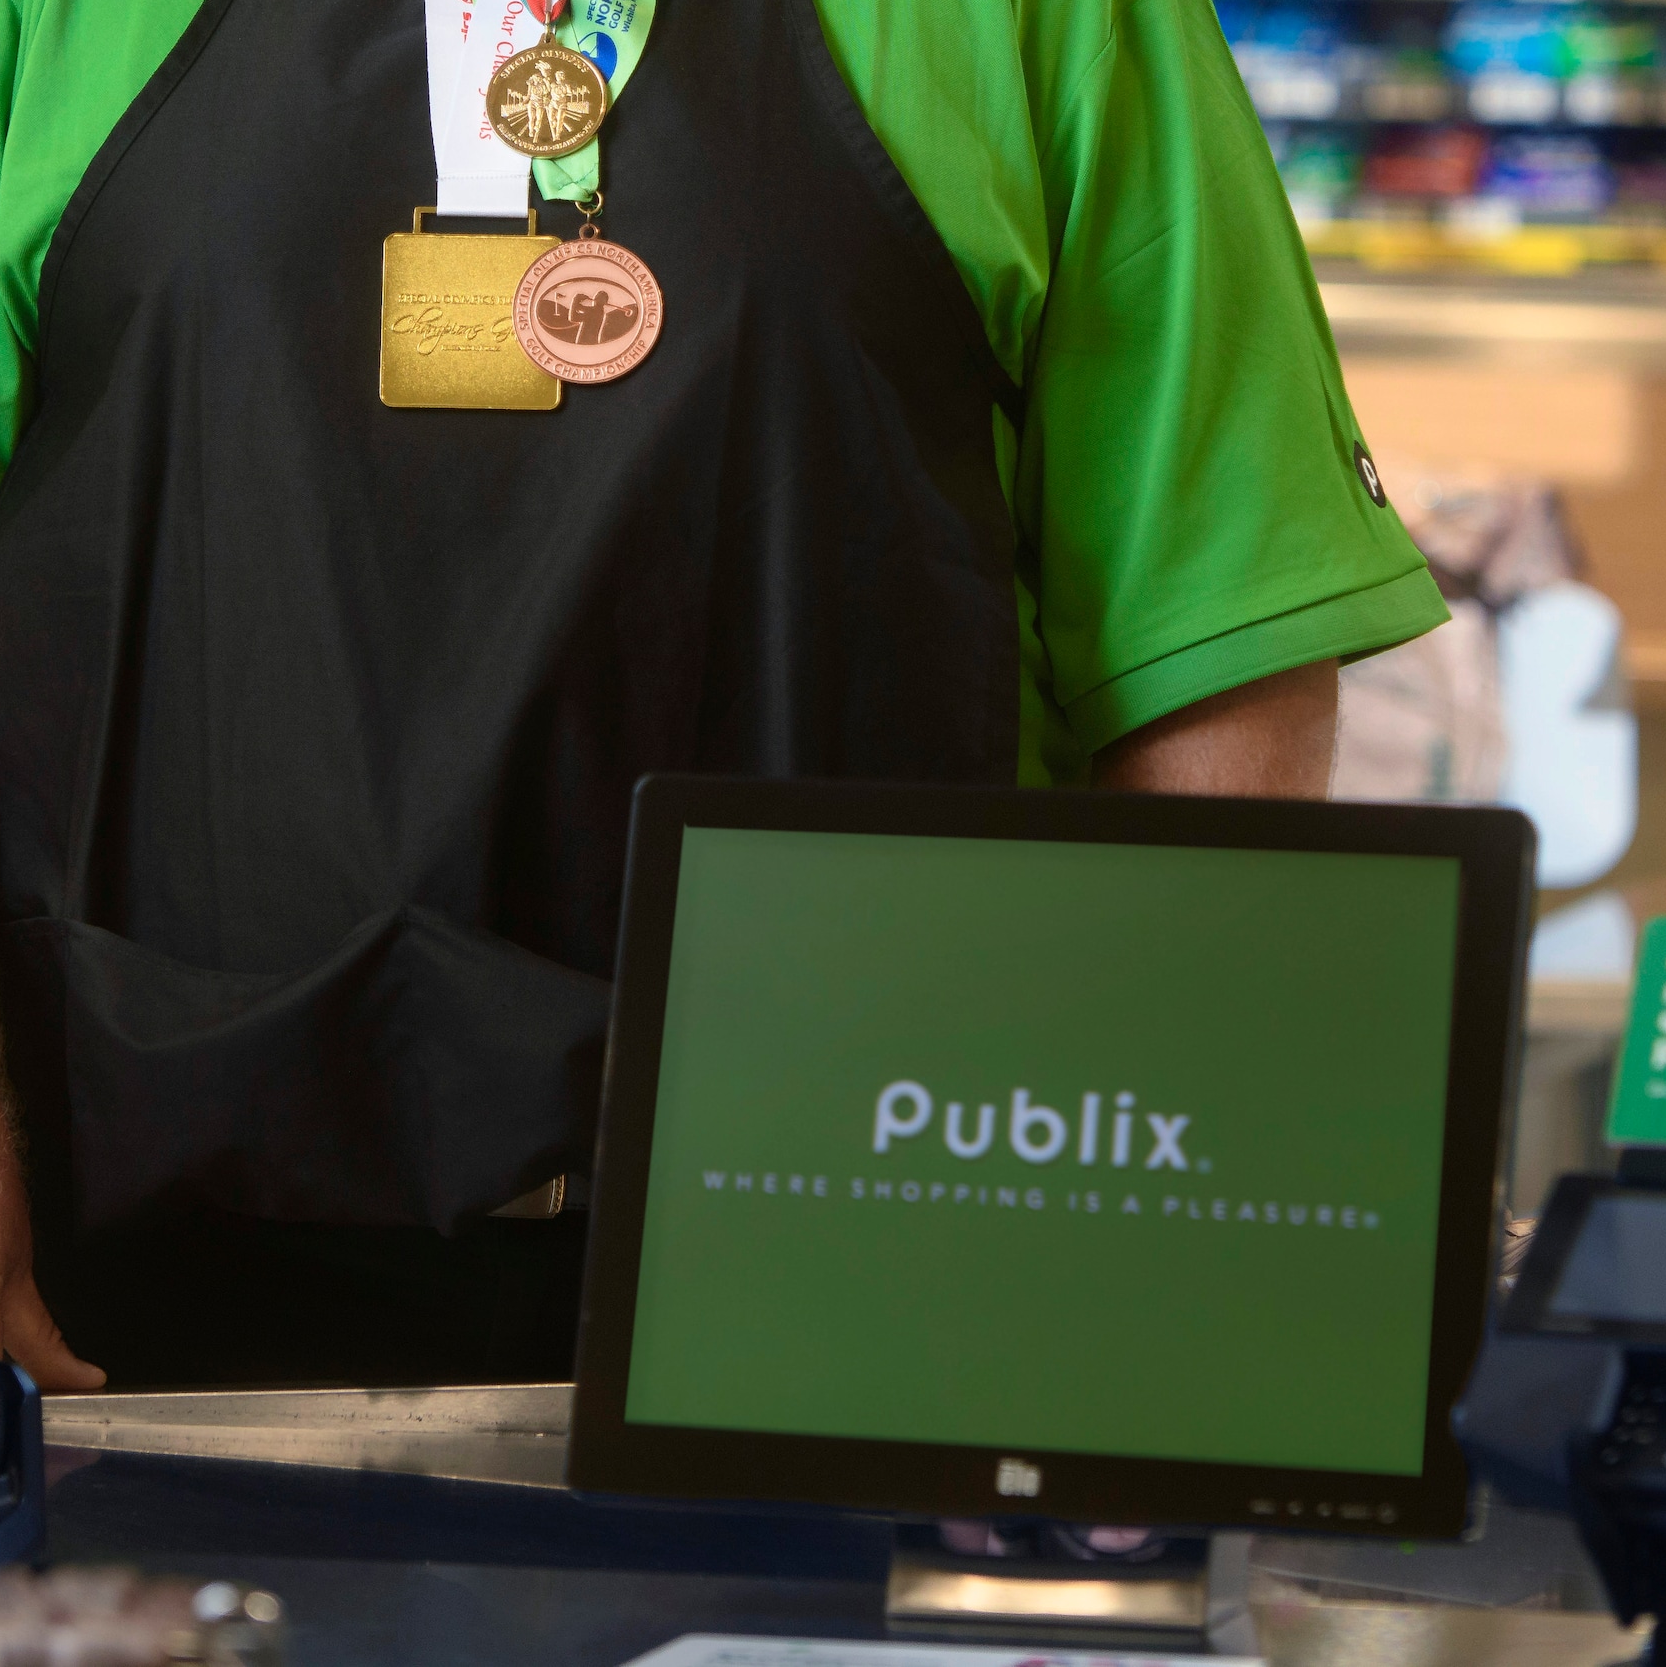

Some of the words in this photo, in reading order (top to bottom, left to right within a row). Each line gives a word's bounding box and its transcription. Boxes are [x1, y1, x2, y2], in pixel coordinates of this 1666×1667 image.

[501, 1, 523, 36] Our
[608, 1, 624, 29] GOLF
[500, 52, 537, 78] SPECIAL
[517, 282, 533, 330] SPECIAL
[597, 244, 640, 272] NORTH
[636, 273, 657, 329] AMERICA
[526, 338, 553, 366] GOLF
[553, 339, 647, 380] CHAMPIONSHIP
[872, 1079, 1191, 1172] Publix
[703, 1170, 828, 1197] WHERE
[851, 1178, 1045, 1210] SHOPPING
[1068, 1190, 1101, 1214] IS
[1121, 1195, 1141, 1215] A
